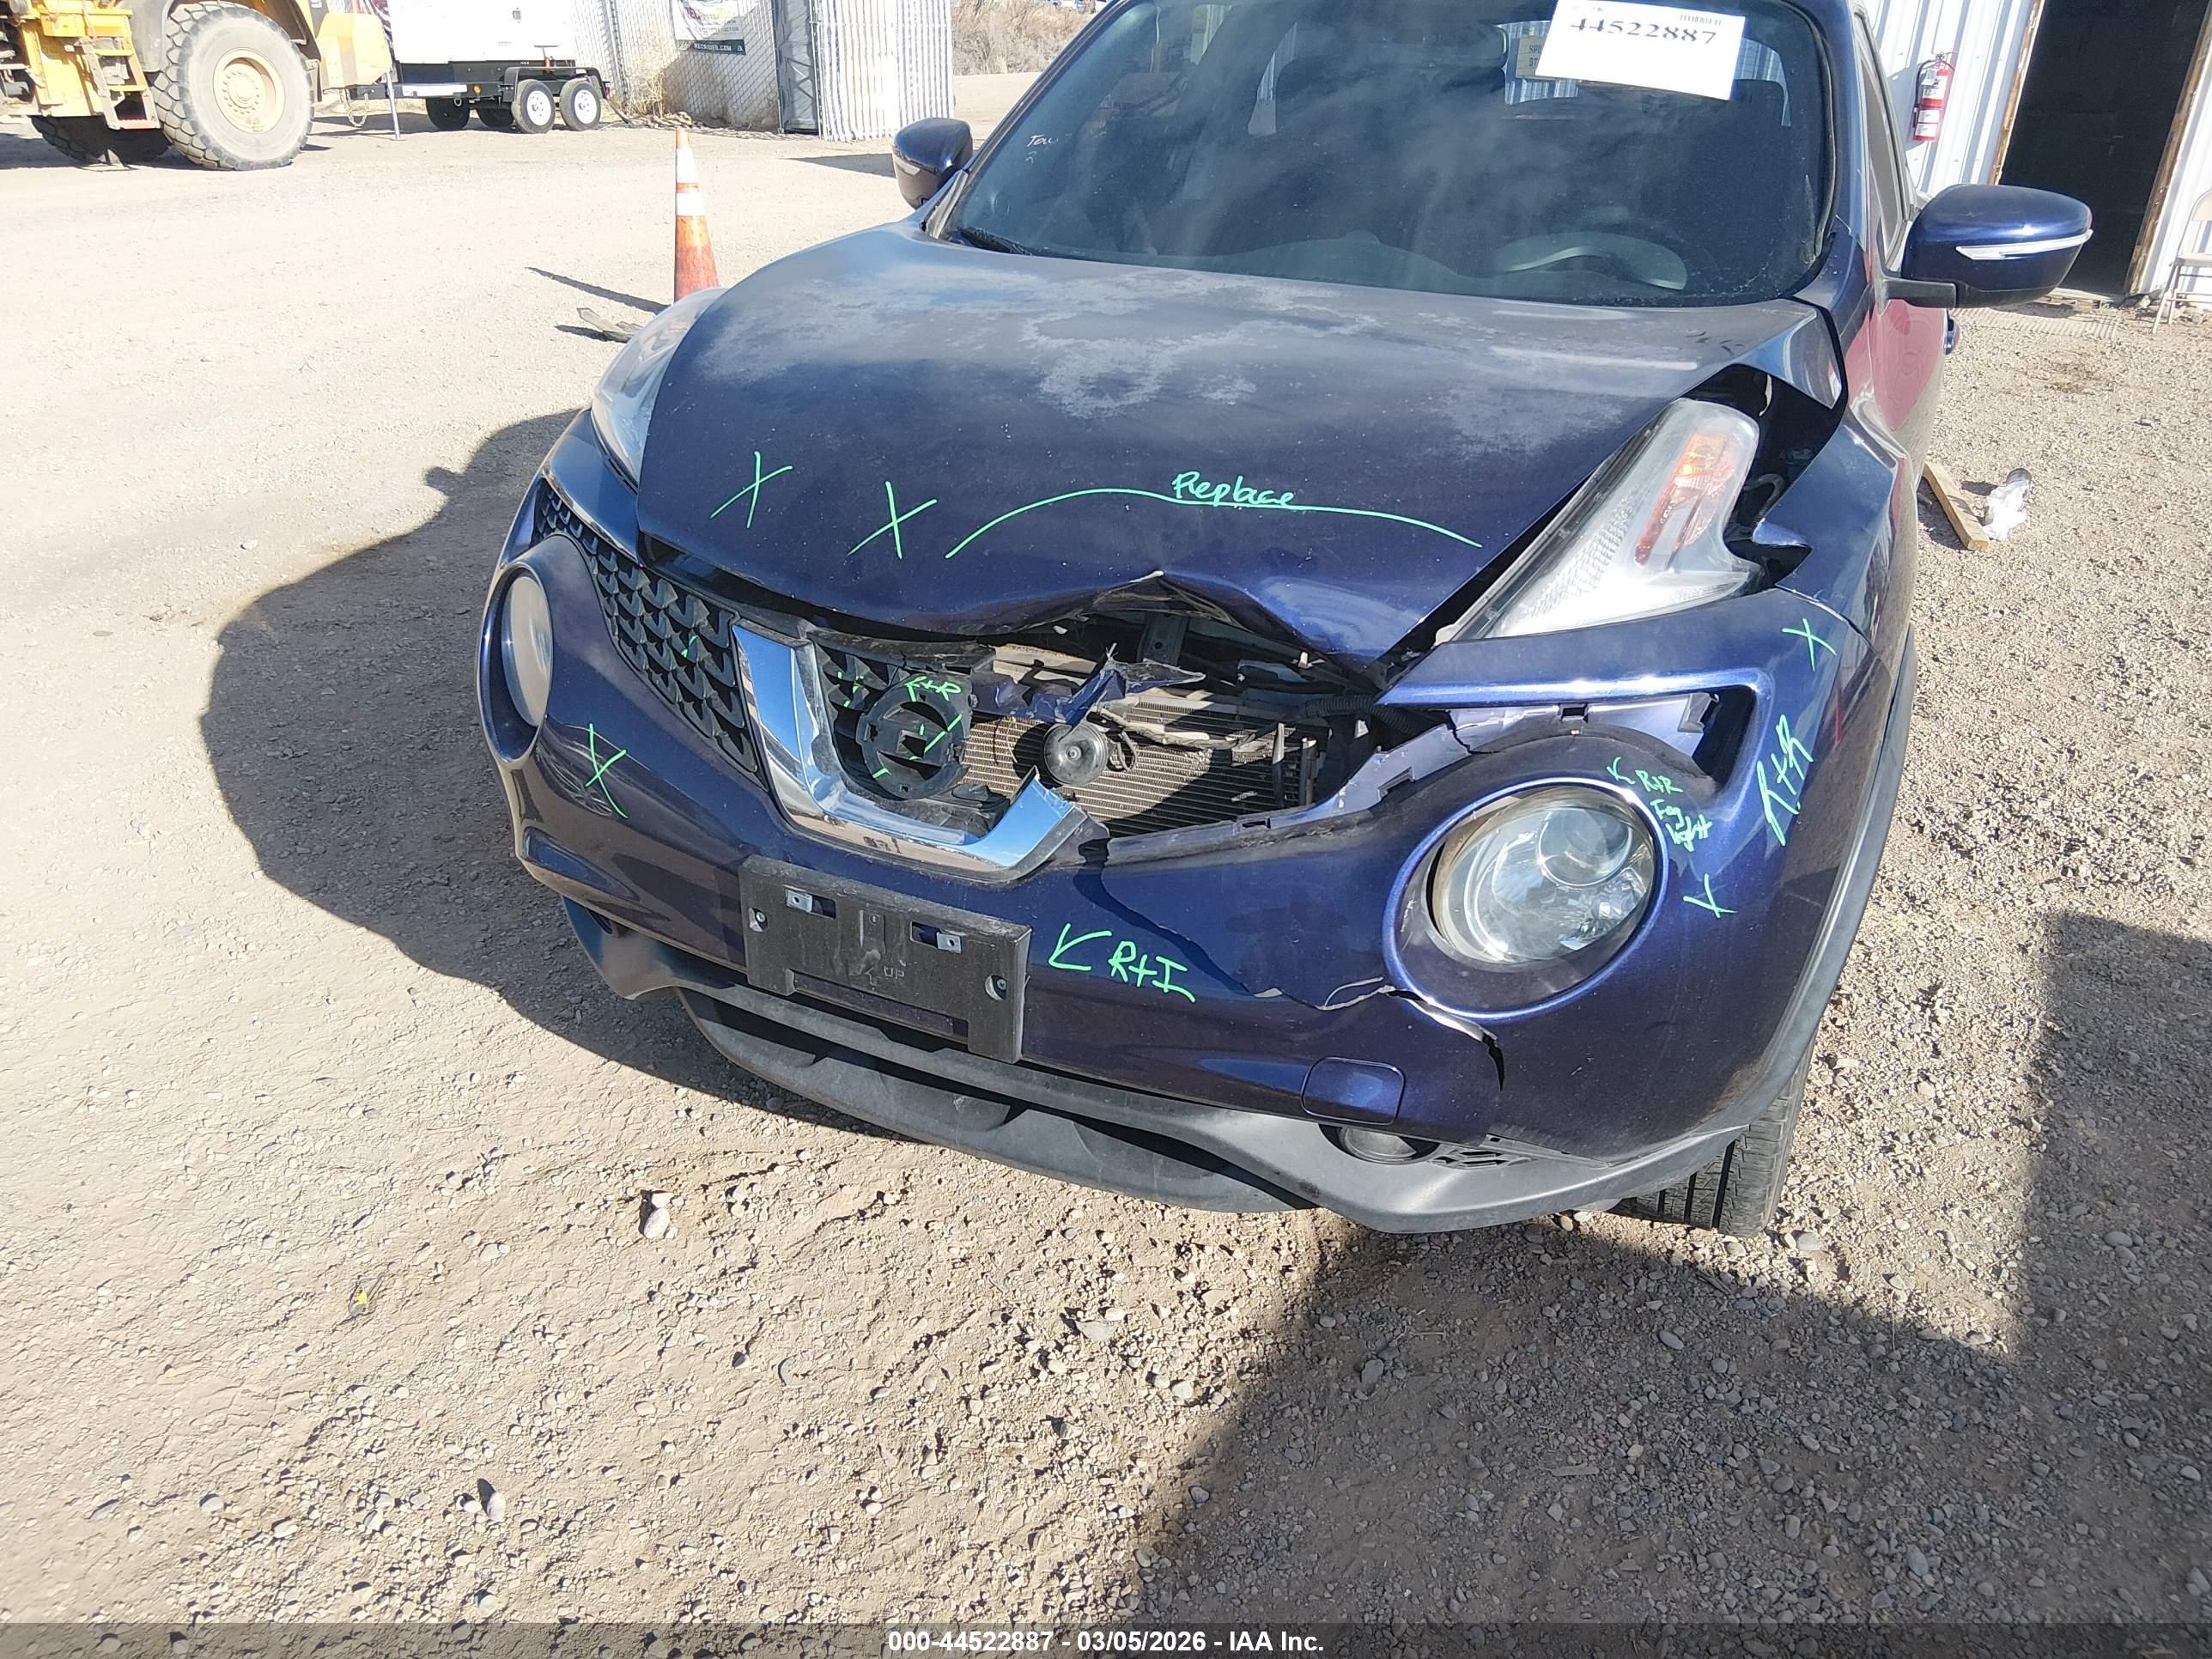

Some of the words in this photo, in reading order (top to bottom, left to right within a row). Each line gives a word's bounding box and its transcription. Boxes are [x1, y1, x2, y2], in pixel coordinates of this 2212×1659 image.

[1570, 17, 1717, 45] 44522887
[1171, 471, 1294, 507] Replace
[1108, 940, 1196, 1003] R+I
